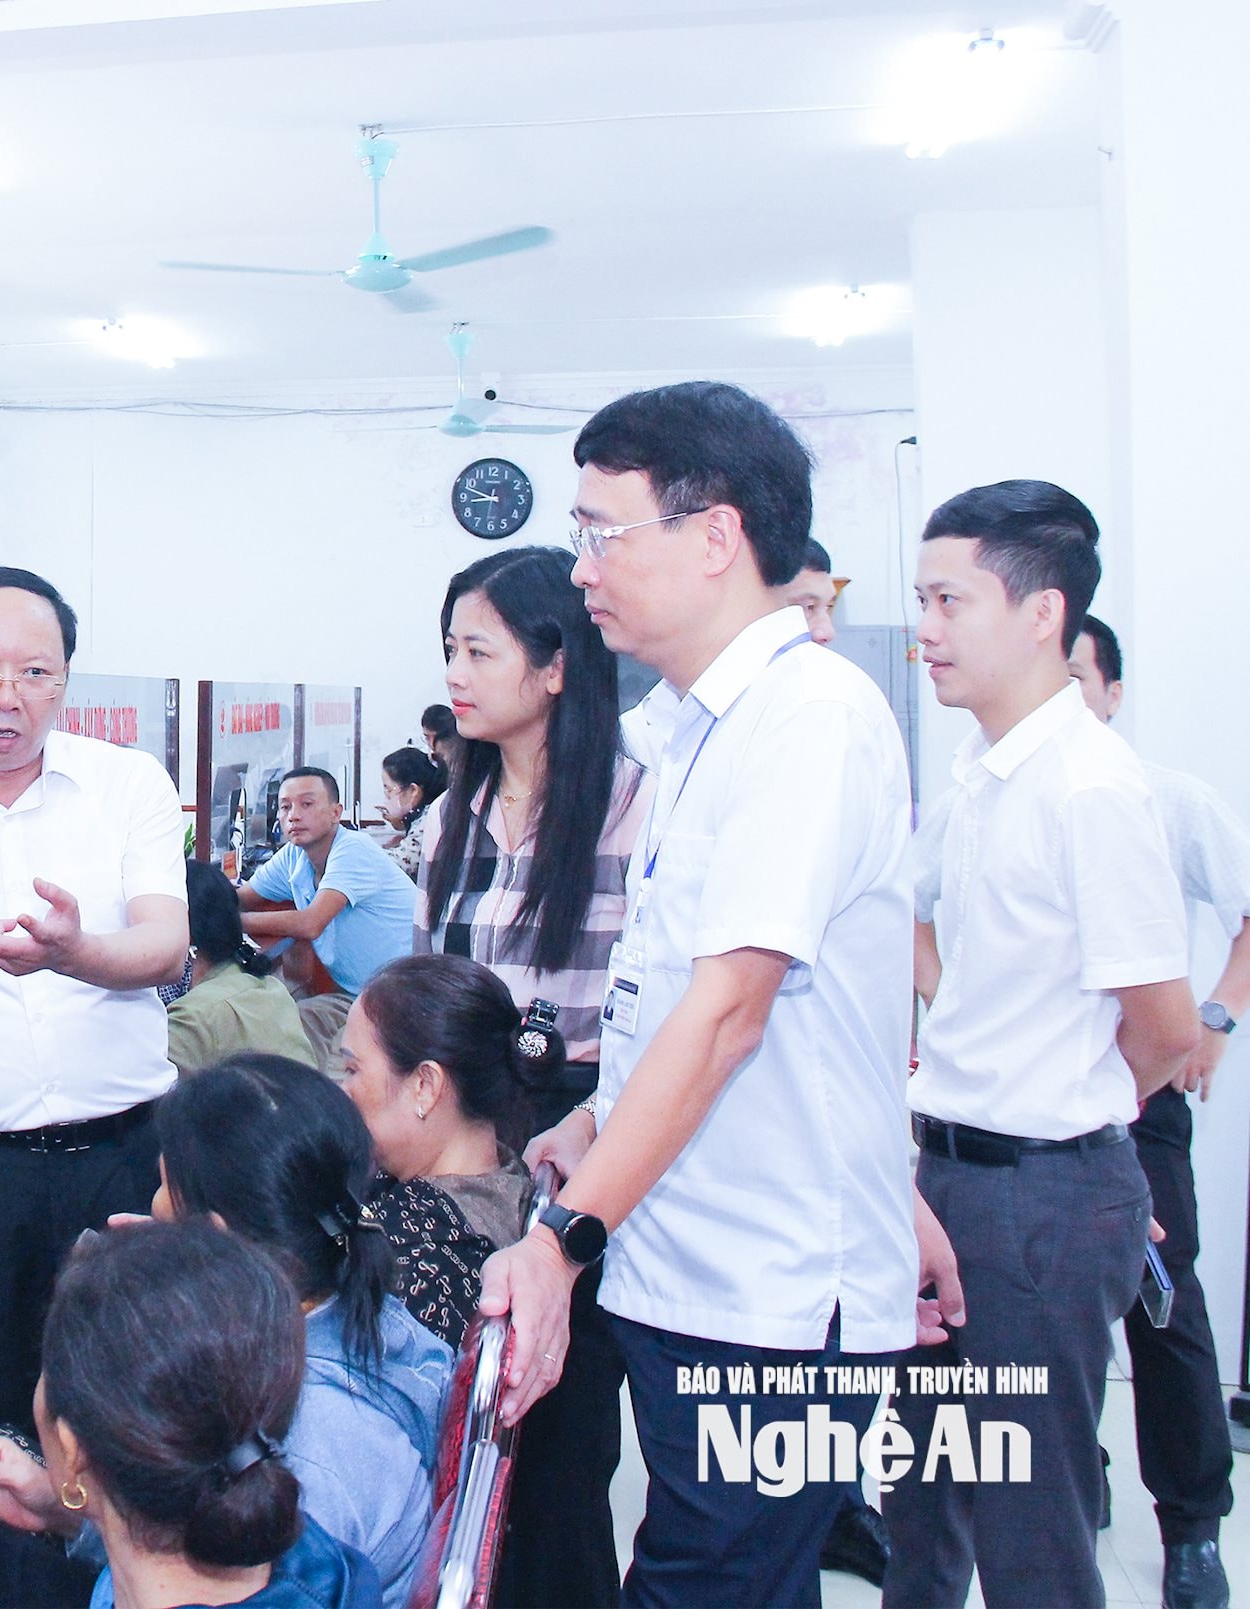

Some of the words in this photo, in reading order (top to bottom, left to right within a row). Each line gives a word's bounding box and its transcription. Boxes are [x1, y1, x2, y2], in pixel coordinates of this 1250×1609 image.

[488, 466, 499, 477] 12
[513, 480, 520, 490] 2
[460, 493, 467, 503] 9
[517, 494, 525, 505] 3
[464, 507, 471, 517] 8
[511, 509, 518, 519] 4
[474, 517, 481, 527] 7
[487, 521, 494, 531] 6
[500, 519, 507, 529] 5
